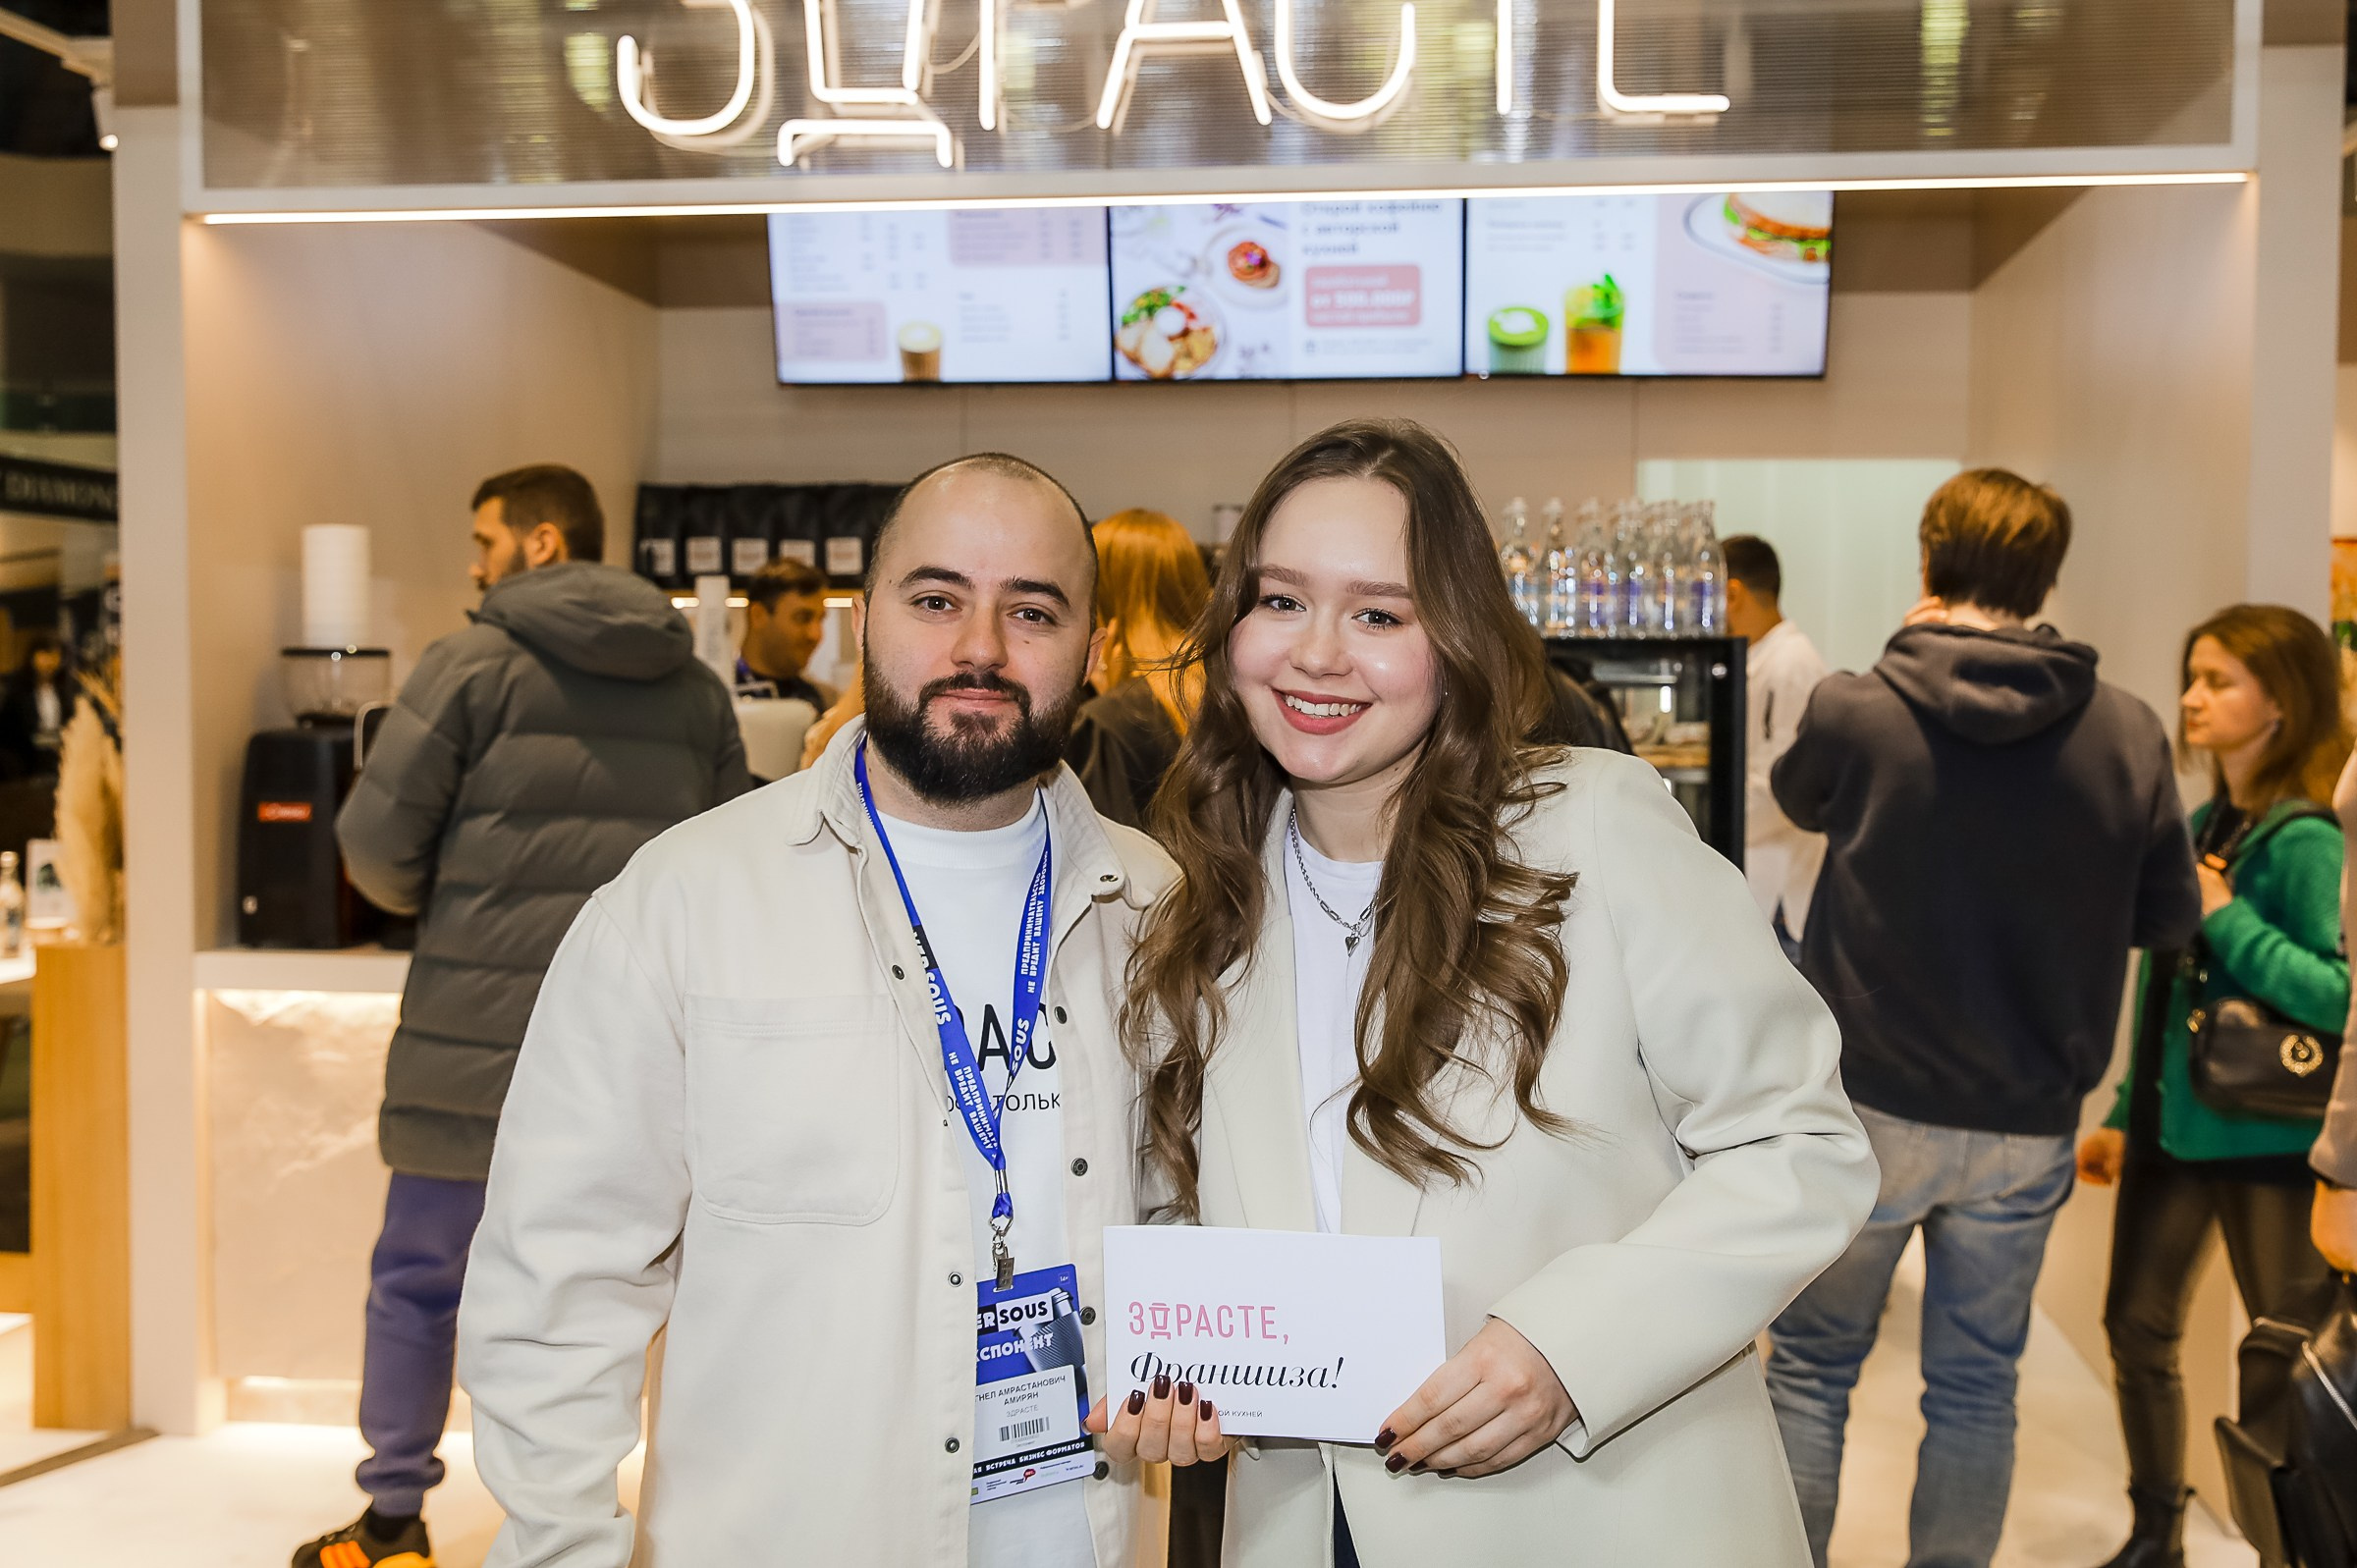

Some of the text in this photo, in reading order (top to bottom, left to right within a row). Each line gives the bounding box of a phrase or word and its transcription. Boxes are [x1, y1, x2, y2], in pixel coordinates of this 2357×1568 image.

[1034, 900, 1044, 937] ВАШЕМУ
[1029, 942, 1041, 977] ВРЕДИТ
[1027, 981, 1036, 994] НЕ
[949, 1052, 959, 1065] НЕ
[955, 1068, 974, 1107] ВРЕДИТ
[968, 1110, 993, 1149] ВАШЕМУ
[977, 1301, 1048, 1328] ERSOUS
[1128, 1301, 1289, 1344] ЗДРАСТЕ,
[1130, 1351, 1344, 1389] Франшиза!
[998, 1376, 1066, 1397] АМРАСТАНОВИЧ
[1004, 1392, 1039, 1405] АМИРЯН
[986, 1459, 1016, 1471] ВСТРЕЧА
[1019, 1451, 1045, 1463] БИЗНЕС
